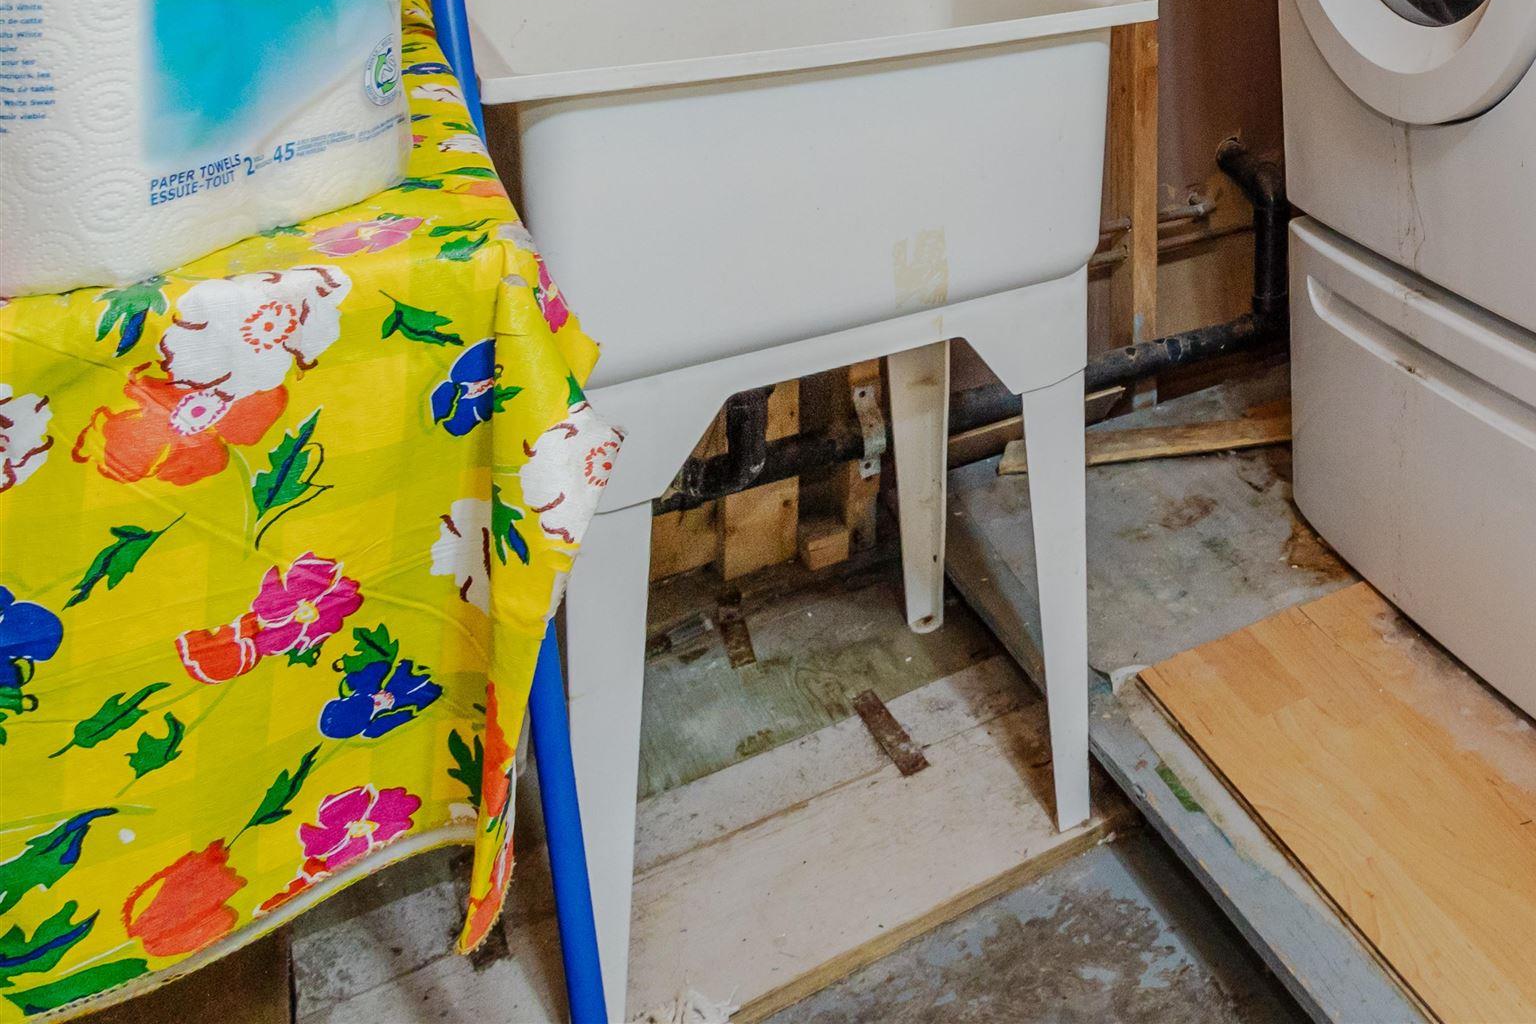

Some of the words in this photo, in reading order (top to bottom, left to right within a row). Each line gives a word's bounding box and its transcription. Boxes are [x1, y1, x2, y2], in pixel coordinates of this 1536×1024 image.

[150, 169, 195, 191] PAPER
[200, 154, 241, 178] TOWELS
[244, 156, 255, 176] 2
[273, 141, 295, 163] 45
[150, 170, 235, 206] ESSUIE-TOUT
